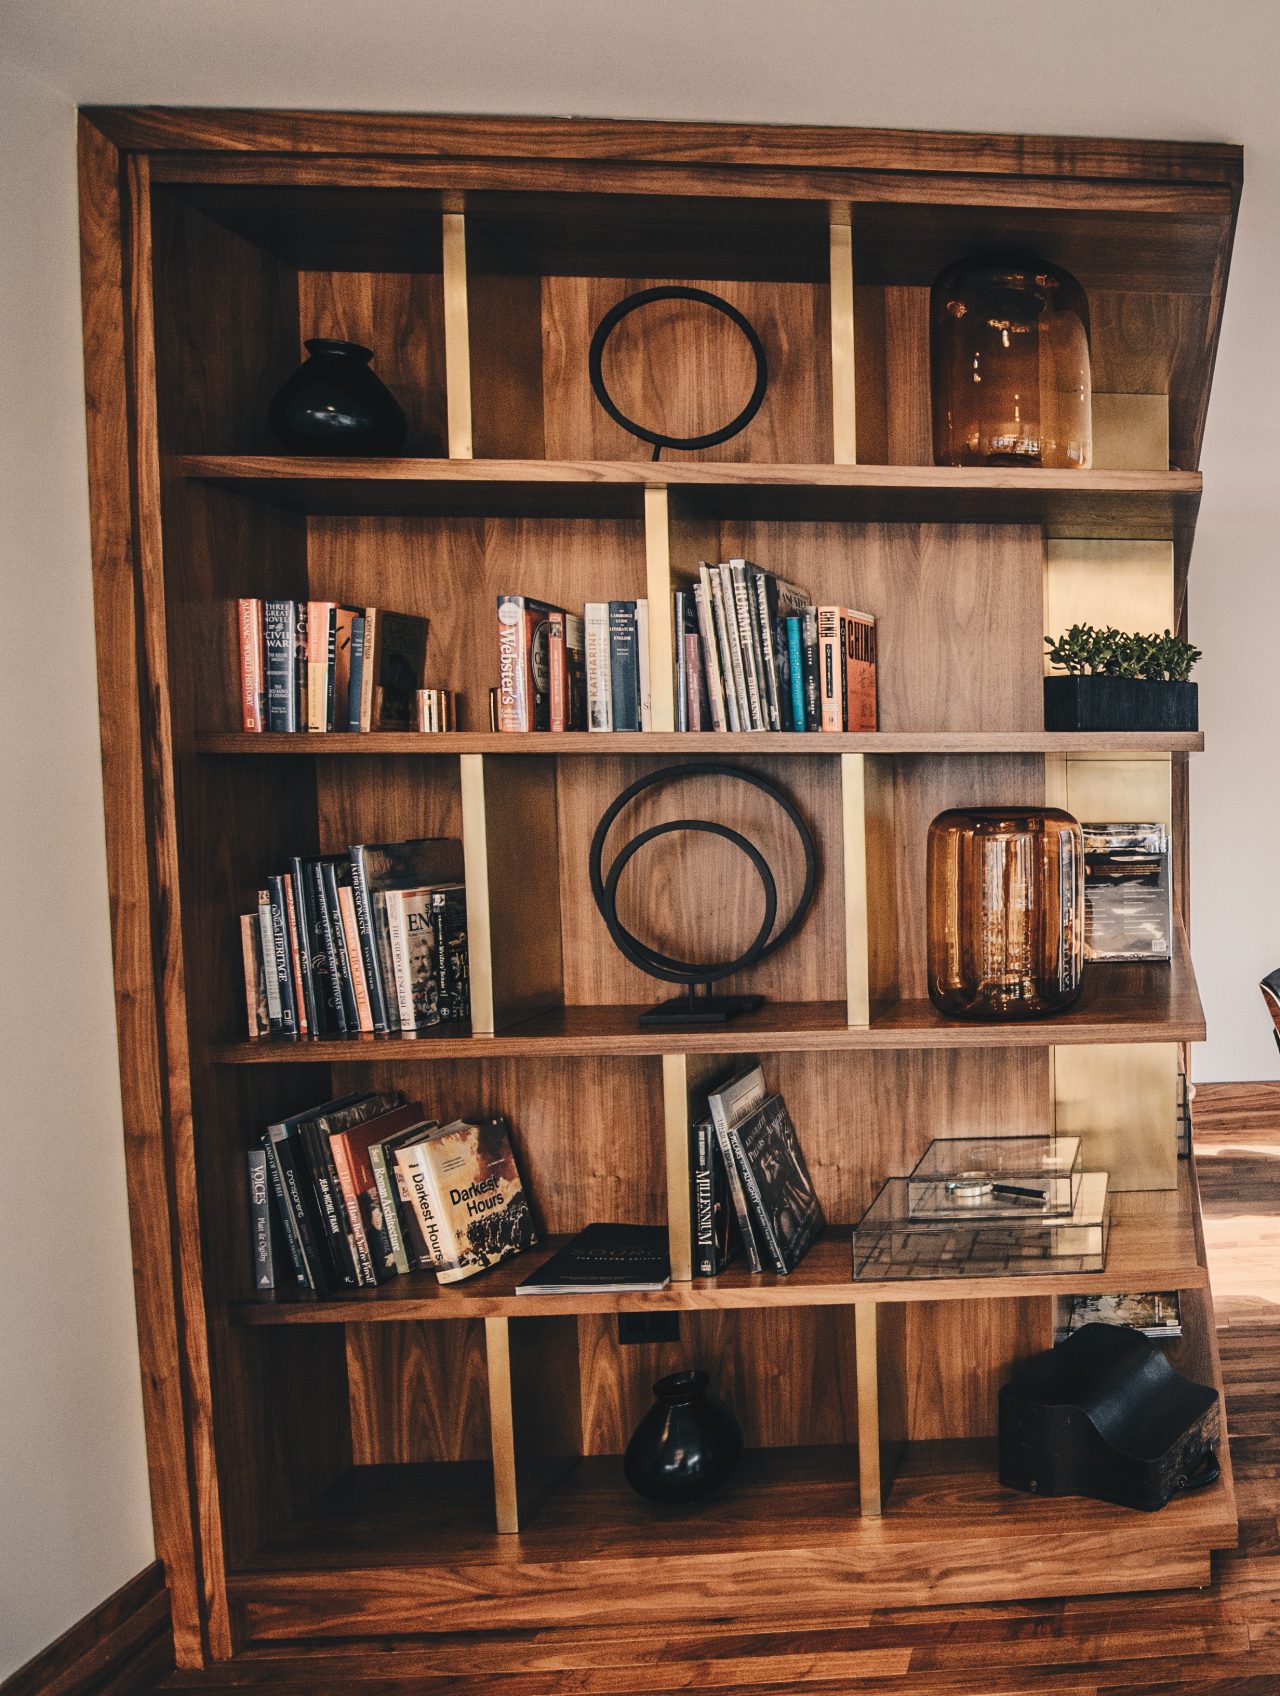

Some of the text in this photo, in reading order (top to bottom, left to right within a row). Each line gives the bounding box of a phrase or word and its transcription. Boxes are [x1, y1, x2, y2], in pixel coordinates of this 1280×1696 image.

[242, 601, 250, 638] ALMANAC
[266, 632, 291, 640] CIVIL
[734, 583, 752, 649] HUMMEL
[820, 611, 837, 638] CHINA
[244, 644, 252, 673] WORLD
[266, 640, 290, 648] WAR
[589, 632, 598, 698] KATHARINE
[848, 620, 875, 665] CHINA
[246, 673, 254, 706] HISTORY
[500, 628, 517, 706] Webster's
[792, 672, 801, 704] license
[748, 677, 759, 720] EHRMANN
[351, 863, 366, 935] IMPRESSIONISTS
[274, 933, 288, 982] HERITAGE
[318, 894, 329, 927] PRINCELY
[324, 928, 334, 954] FEASTS
[331, 972, 342, 1009] FESTIVALS
[350, 949, 366, 1006] CHOCOLATE
[254, 1165, 266, 1205] VOICES
[272, 1170, 280, 1182] THE
[274, 1182, 283, 1197] FREE
[729, 1133, 743, 1159] PILLARS
[743, 1170, 759, 1203] ALMIGHTY
[286, 1170, 304, 1218] transparent
[318, 1178, 340, 1234] JEAN-MICHEL FRANK
[375, 1168, 400, 1251] Roman Architecture
[450, 1176, 500, 1206] Darkest
[466, 1193, 504, 1217] Hours
[696, 1170, 712, 1246] MILLENNIUM
[412, 1173, 444, 1261] Darkest Hours
